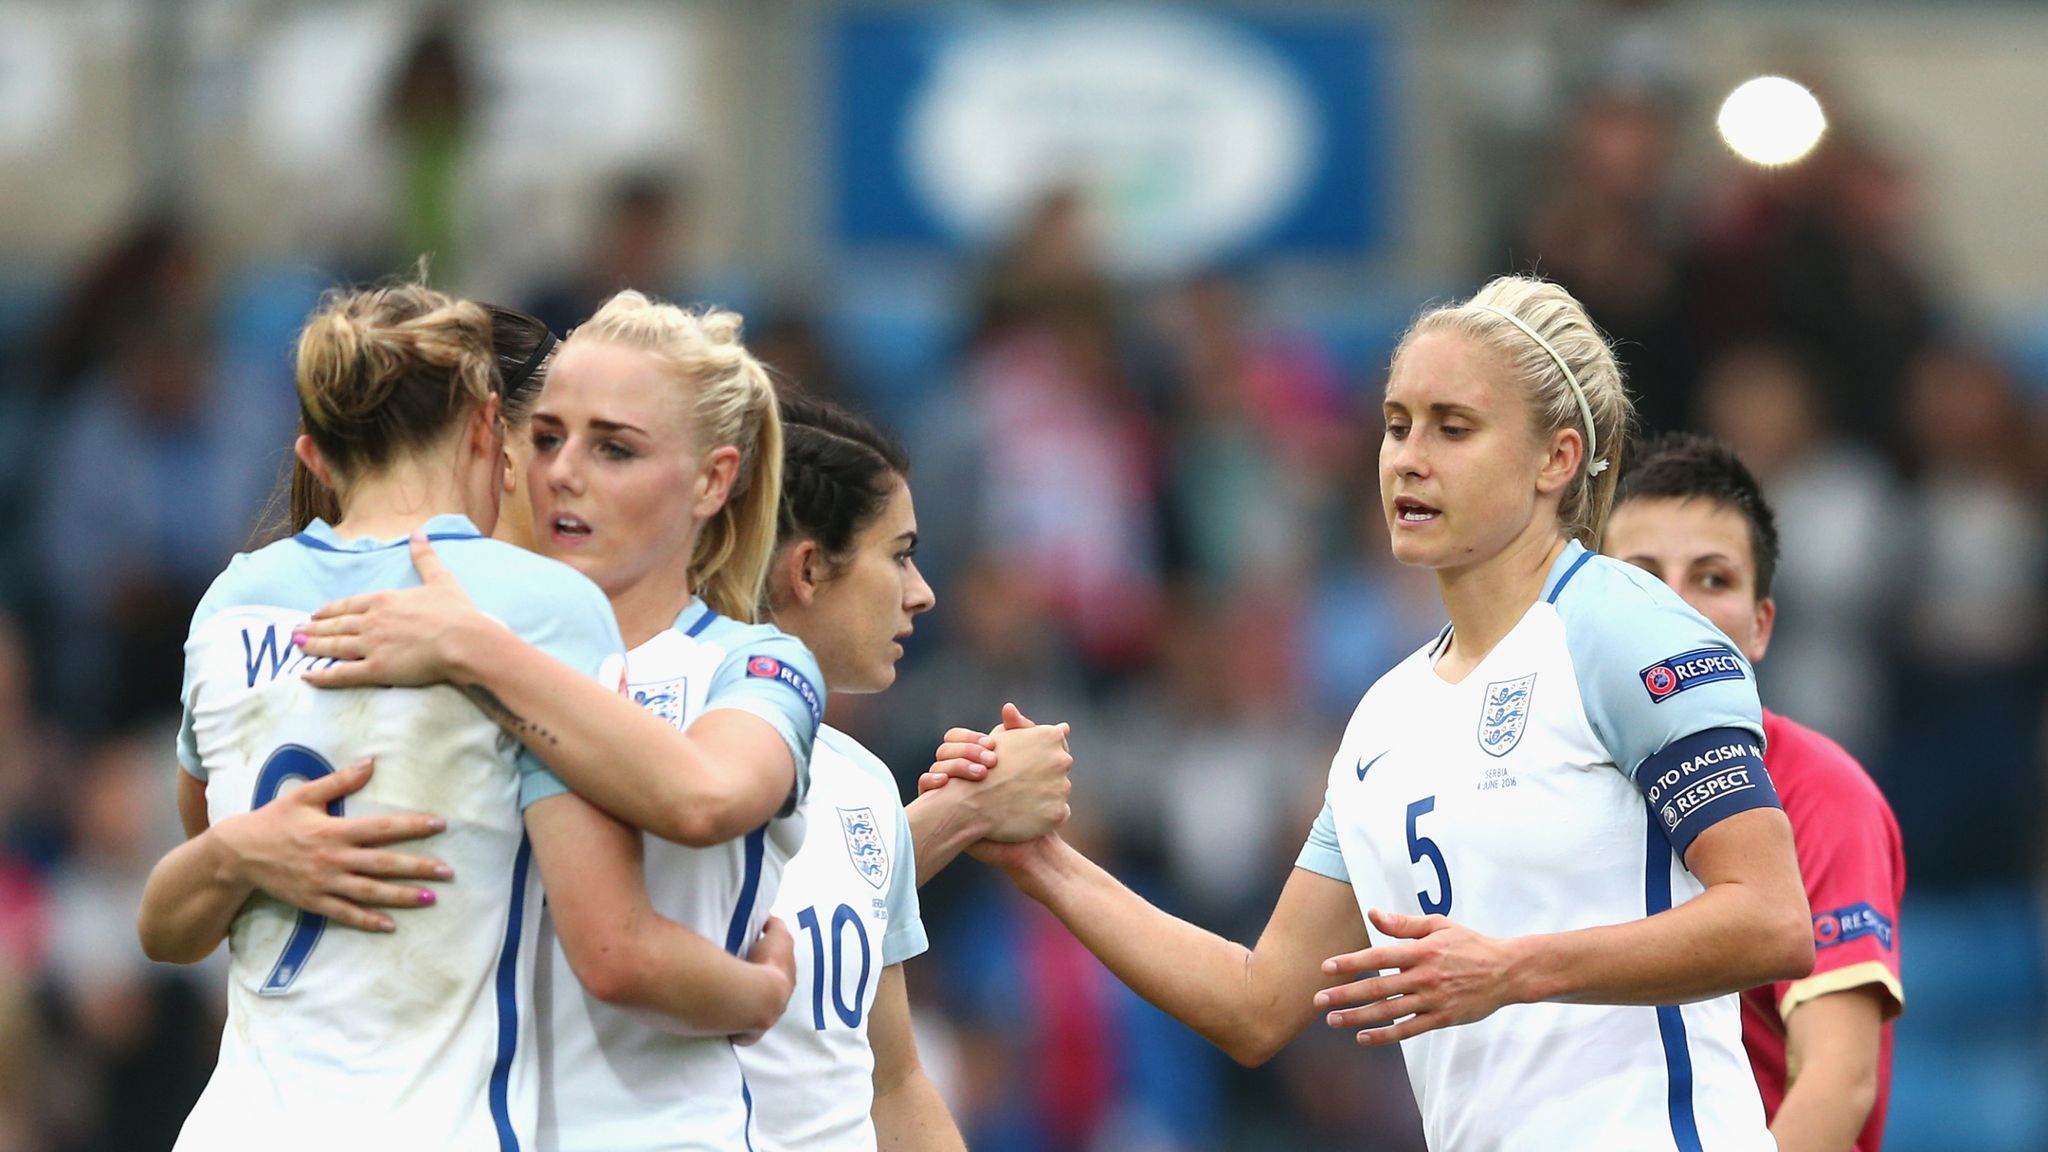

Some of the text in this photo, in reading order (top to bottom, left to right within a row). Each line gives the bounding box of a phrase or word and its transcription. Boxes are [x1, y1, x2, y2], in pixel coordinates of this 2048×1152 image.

[1674, 656, 1739, 680] RESPECT
[1482, 780, 1499, 791] JUNE
[1485, 767, 1507, 779] SERBIA
[1657, 770, 1681, 790] TO
[1681, 744, 1747, 776] RACISM
[1676, 770, 1750, 813] RESPECT
[1406, 795, 1453, 917] 5
[797, 903, 870, 1030] 10
